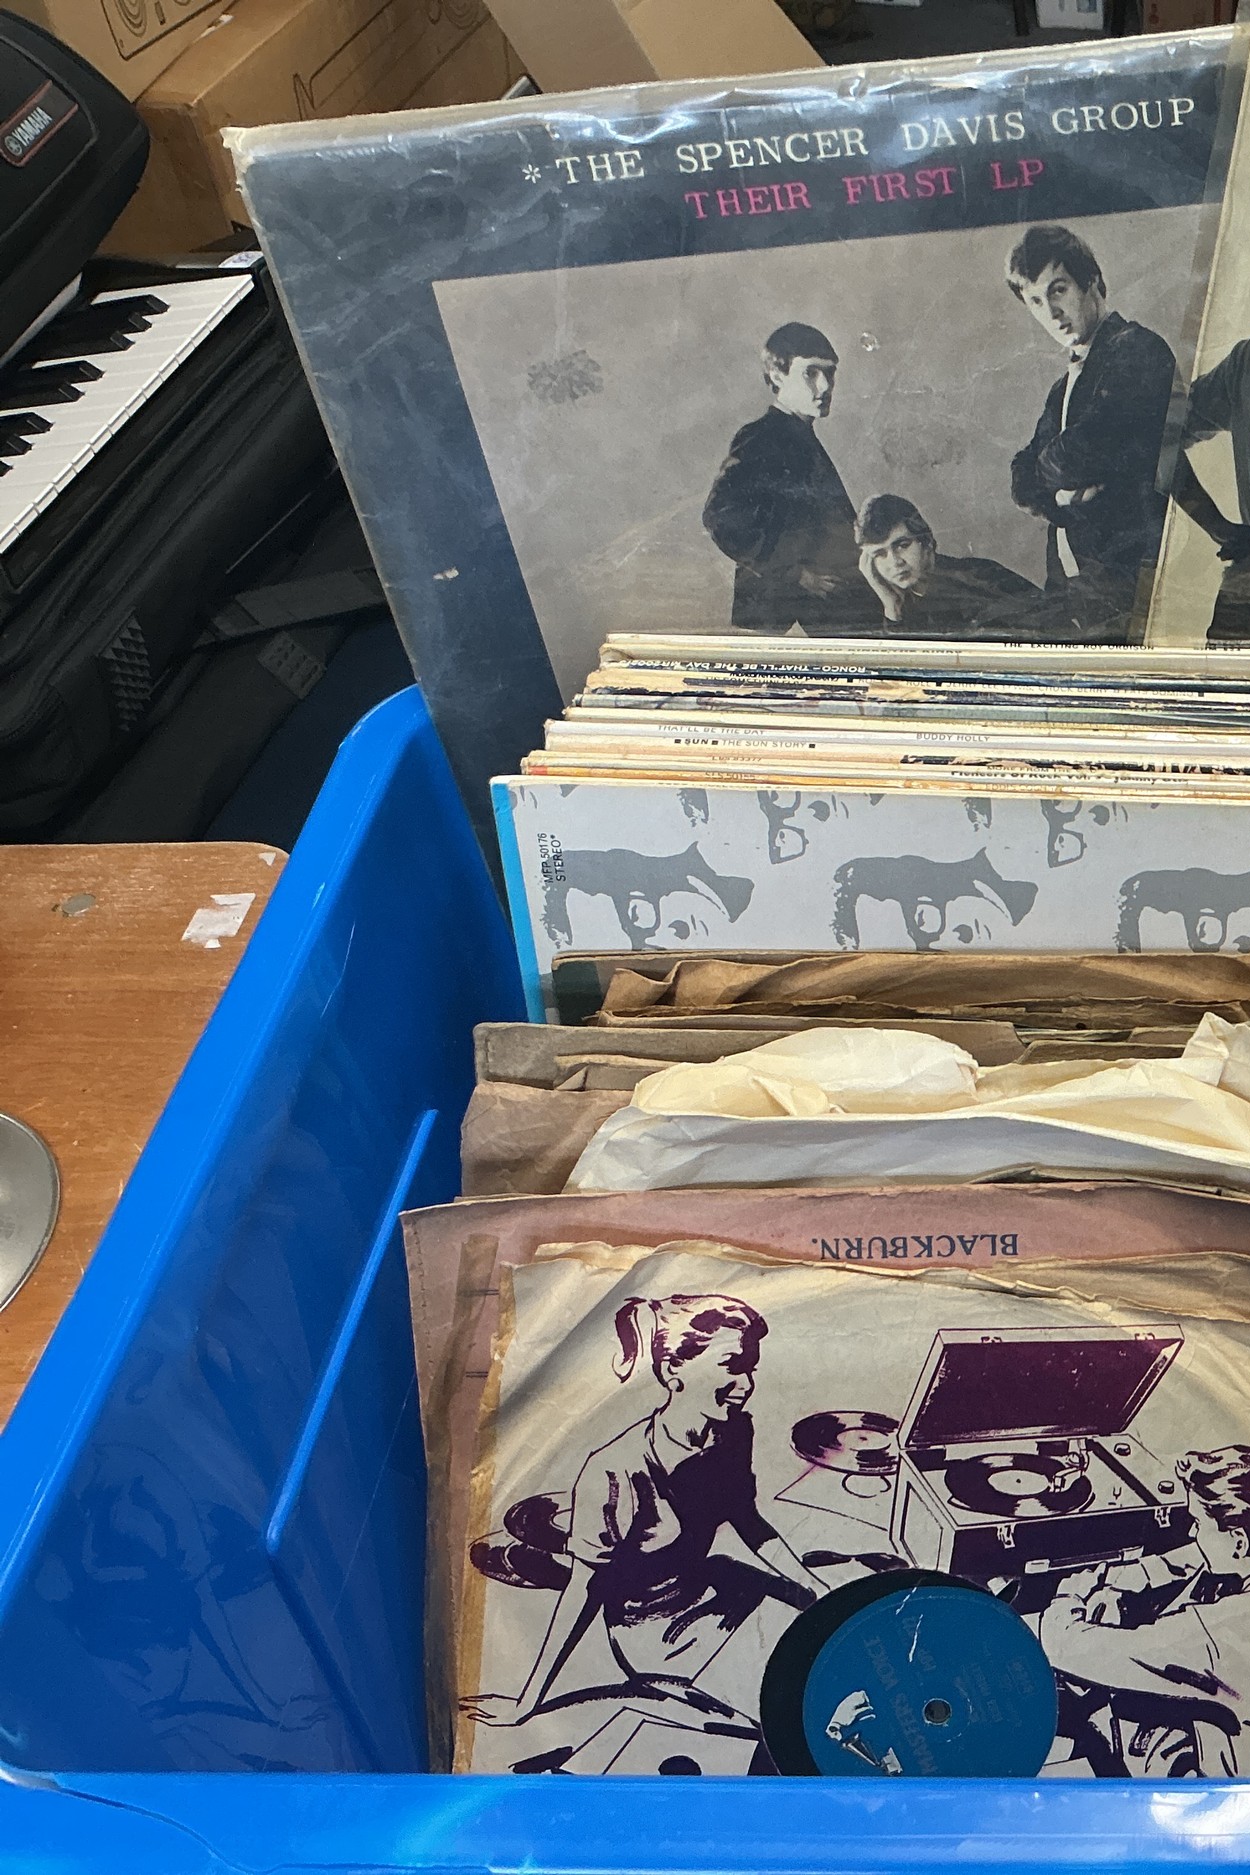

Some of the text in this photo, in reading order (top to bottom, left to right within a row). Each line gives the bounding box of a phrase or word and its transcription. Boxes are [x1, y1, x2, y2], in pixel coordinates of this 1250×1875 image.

[11, 106, 53, 147] YAMAHA
[556, 98, 1197, 185] THE SPENCER DAVIS GROUP
[686, 159, 1046, 220] THEIR FIRST LP
[685, 661, 710, 670] DAY
[713, 662, 740, 672] THE
[741, 662, 758, 671] BE
[822, 665, 867, 674] RONCO
[657, 725, 700, 733] THAT'LL
[916, 732, 990, 743] BUDDY HOLLY
[684, 738, 807, 749] SUN THE SUN STORY
[537, 833, 553, 884] MFP 50176
[811, 1233, 1019, 1261] BLACKBURN.
